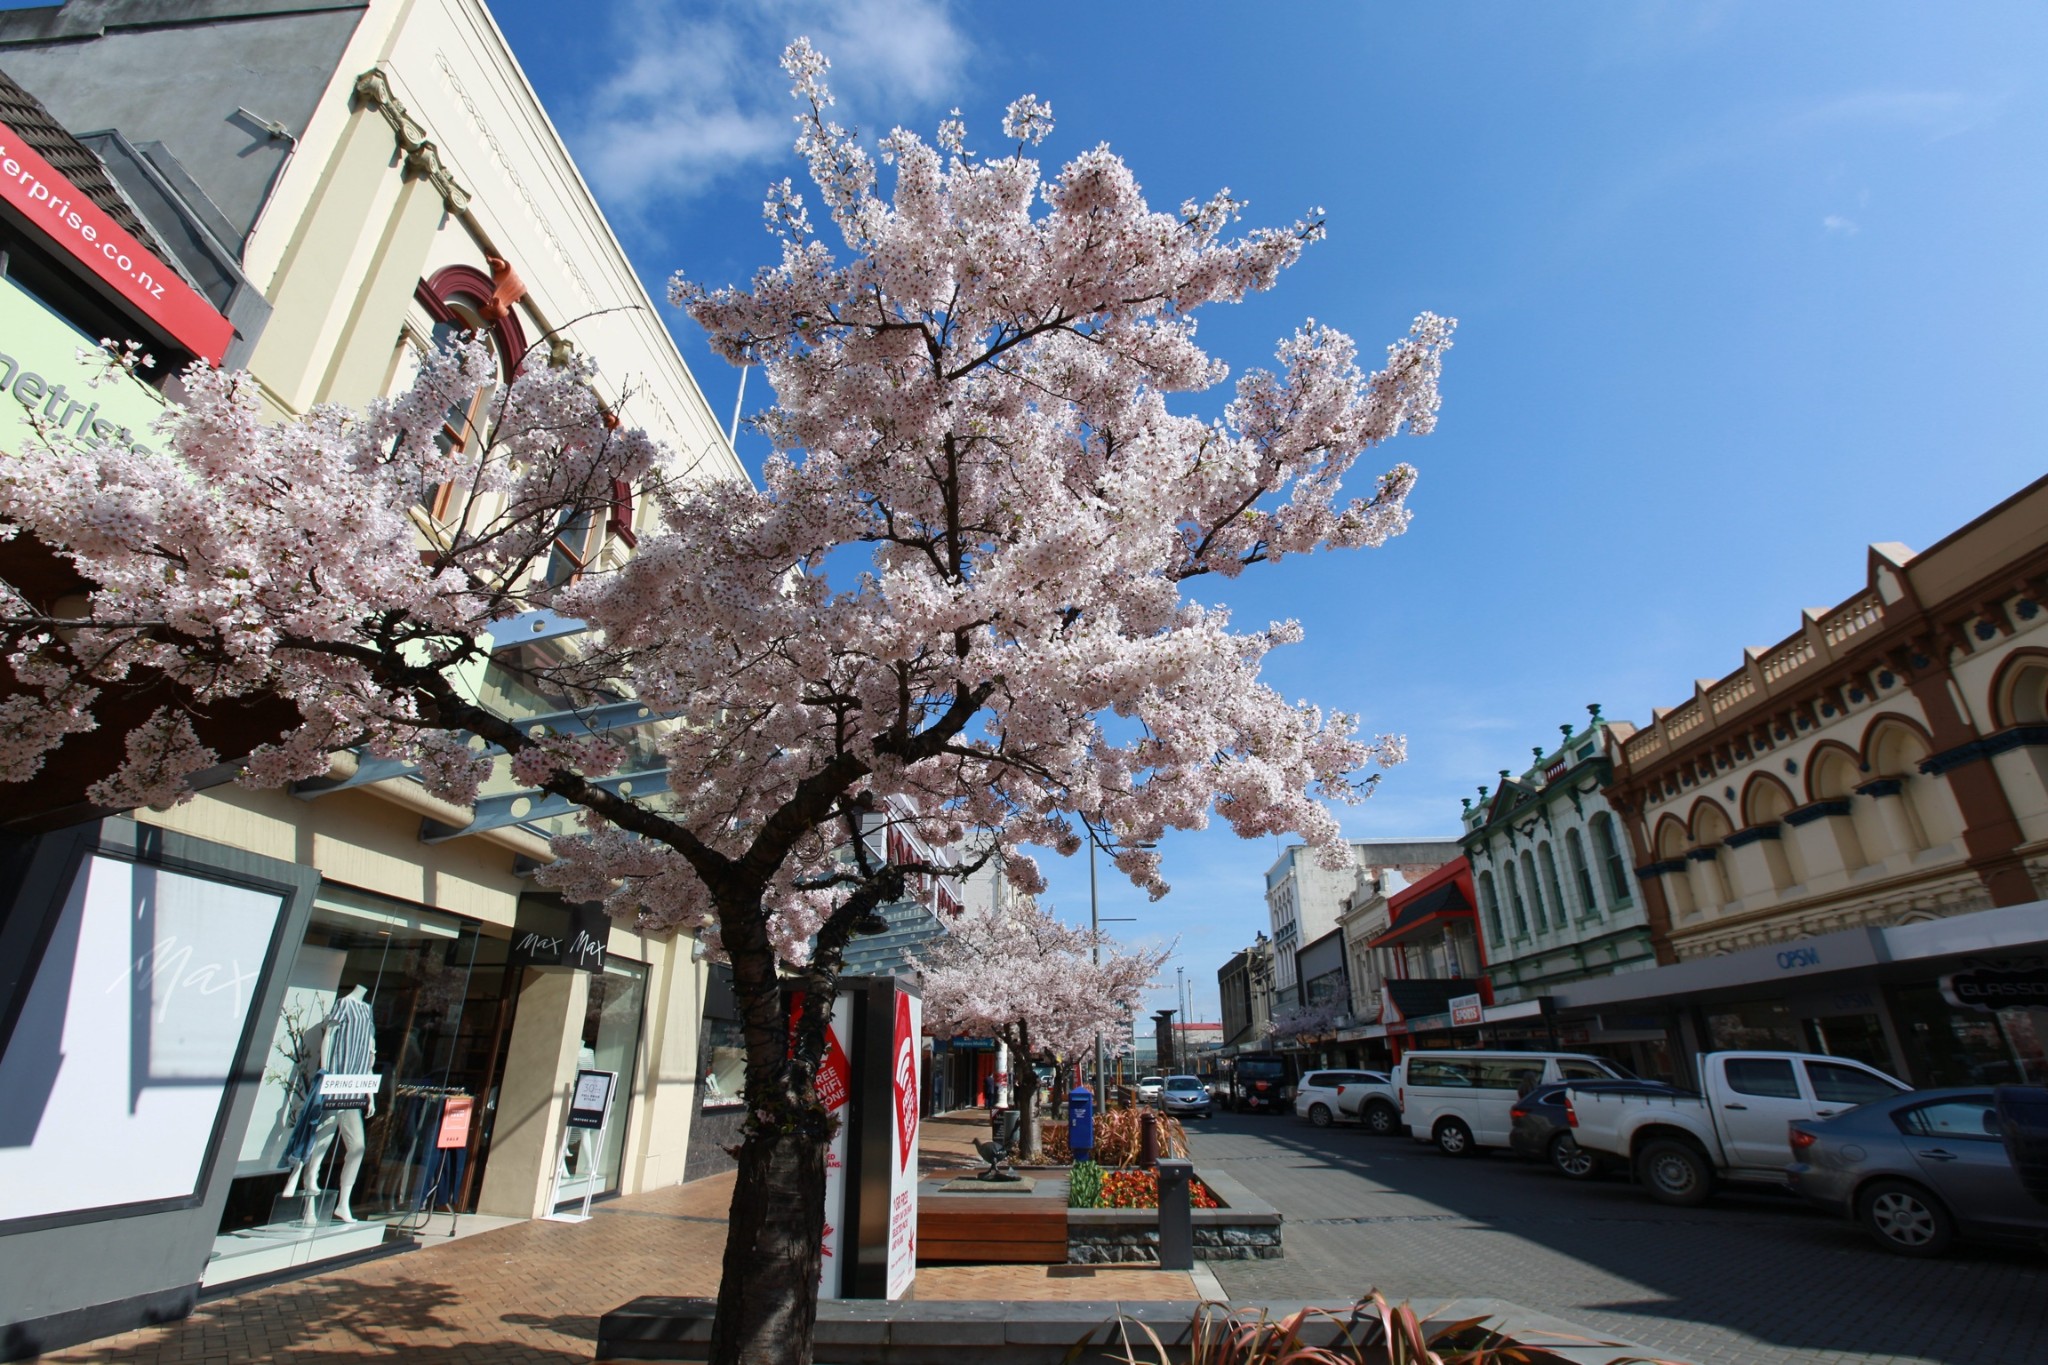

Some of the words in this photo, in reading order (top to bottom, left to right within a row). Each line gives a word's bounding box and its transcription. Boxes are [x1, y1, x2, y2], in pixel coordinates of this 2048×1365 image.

[515, 932, 563, 958] Max
[569, 929, 606, 966] Max
[1776, 946, 1820, 969] OPSM
[104, 935, 260, 1024] Max
[1958, 982, 2048, 996] GLASSO
[325, 1080, 353, 1089] SPRING
[355, 1080, 378, 1089] LINEN
[815, 1066, 837, 1086] REE
[819, 1087, 847, 1106] ONE
